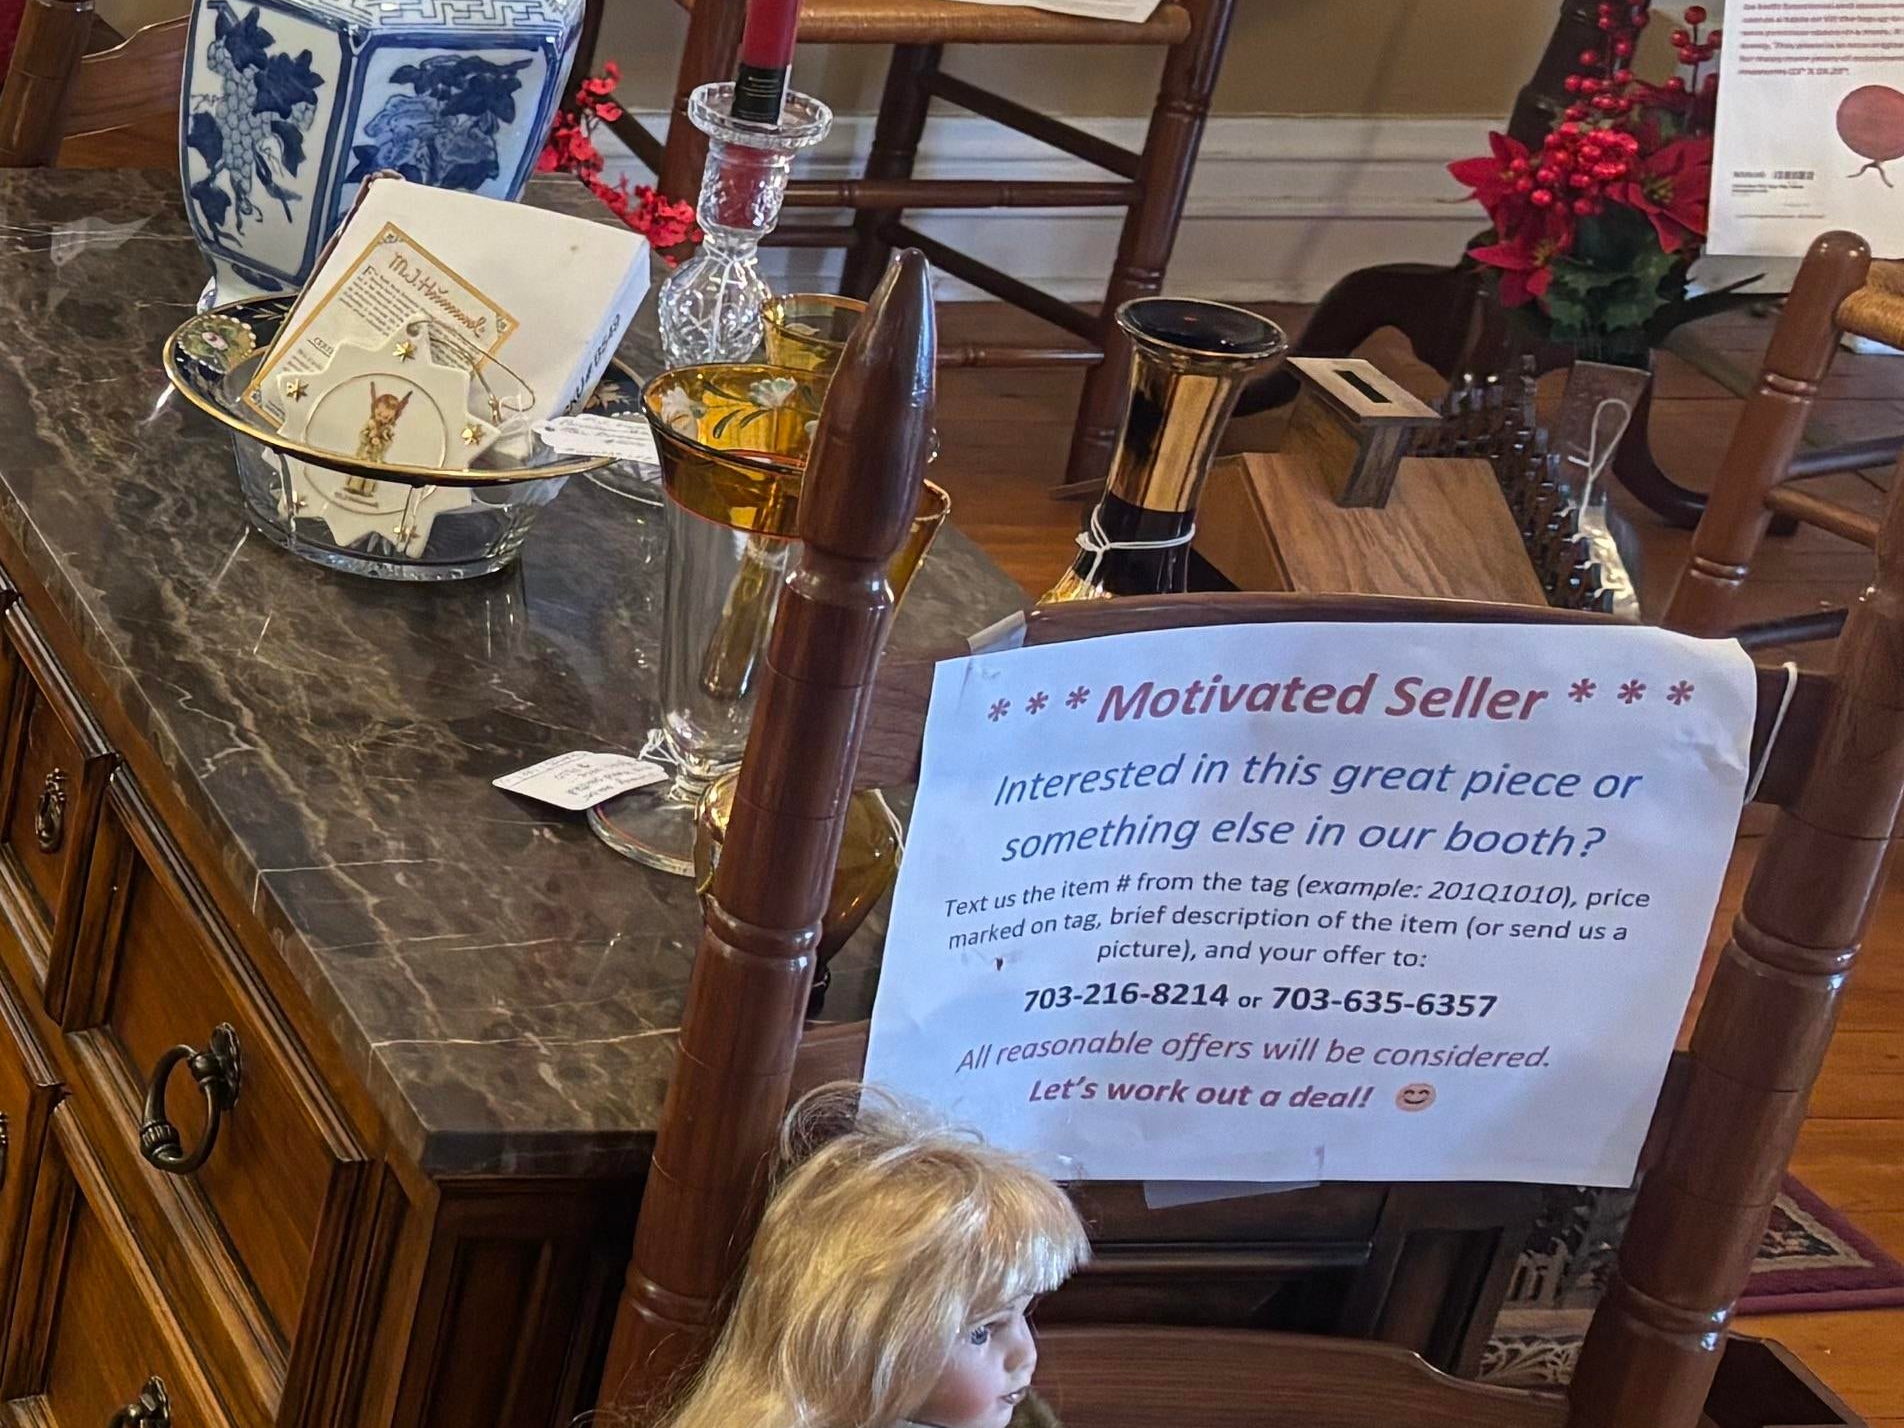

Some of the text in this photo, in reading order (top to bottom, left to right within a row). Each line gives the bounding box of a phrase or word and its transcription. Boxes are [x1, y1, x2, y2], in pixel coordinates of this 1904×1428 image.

[1097, 673, 1548, 722] Motivated Seller
[994, 752, 1643, 806] Interested in this great piece or
[1001, 811, 1606, 862] something else in our booth?
[944, 872, 1650, 917] Text us the item # from the tag (example: 201Q1010), price
[948, 905, 1627, 950] marked on tag, brief description of the item (or send us a
[1097, 939, 1427, 968] picture), and your offer to:
[1024, 983, 1497, 1017] 703-216-8214 or 703-635-6357
[955, 1030, 1550, 1074] All reasonable offers will be considered.
[1029, 1076, 1374, 1108] Let's work out a deal!
